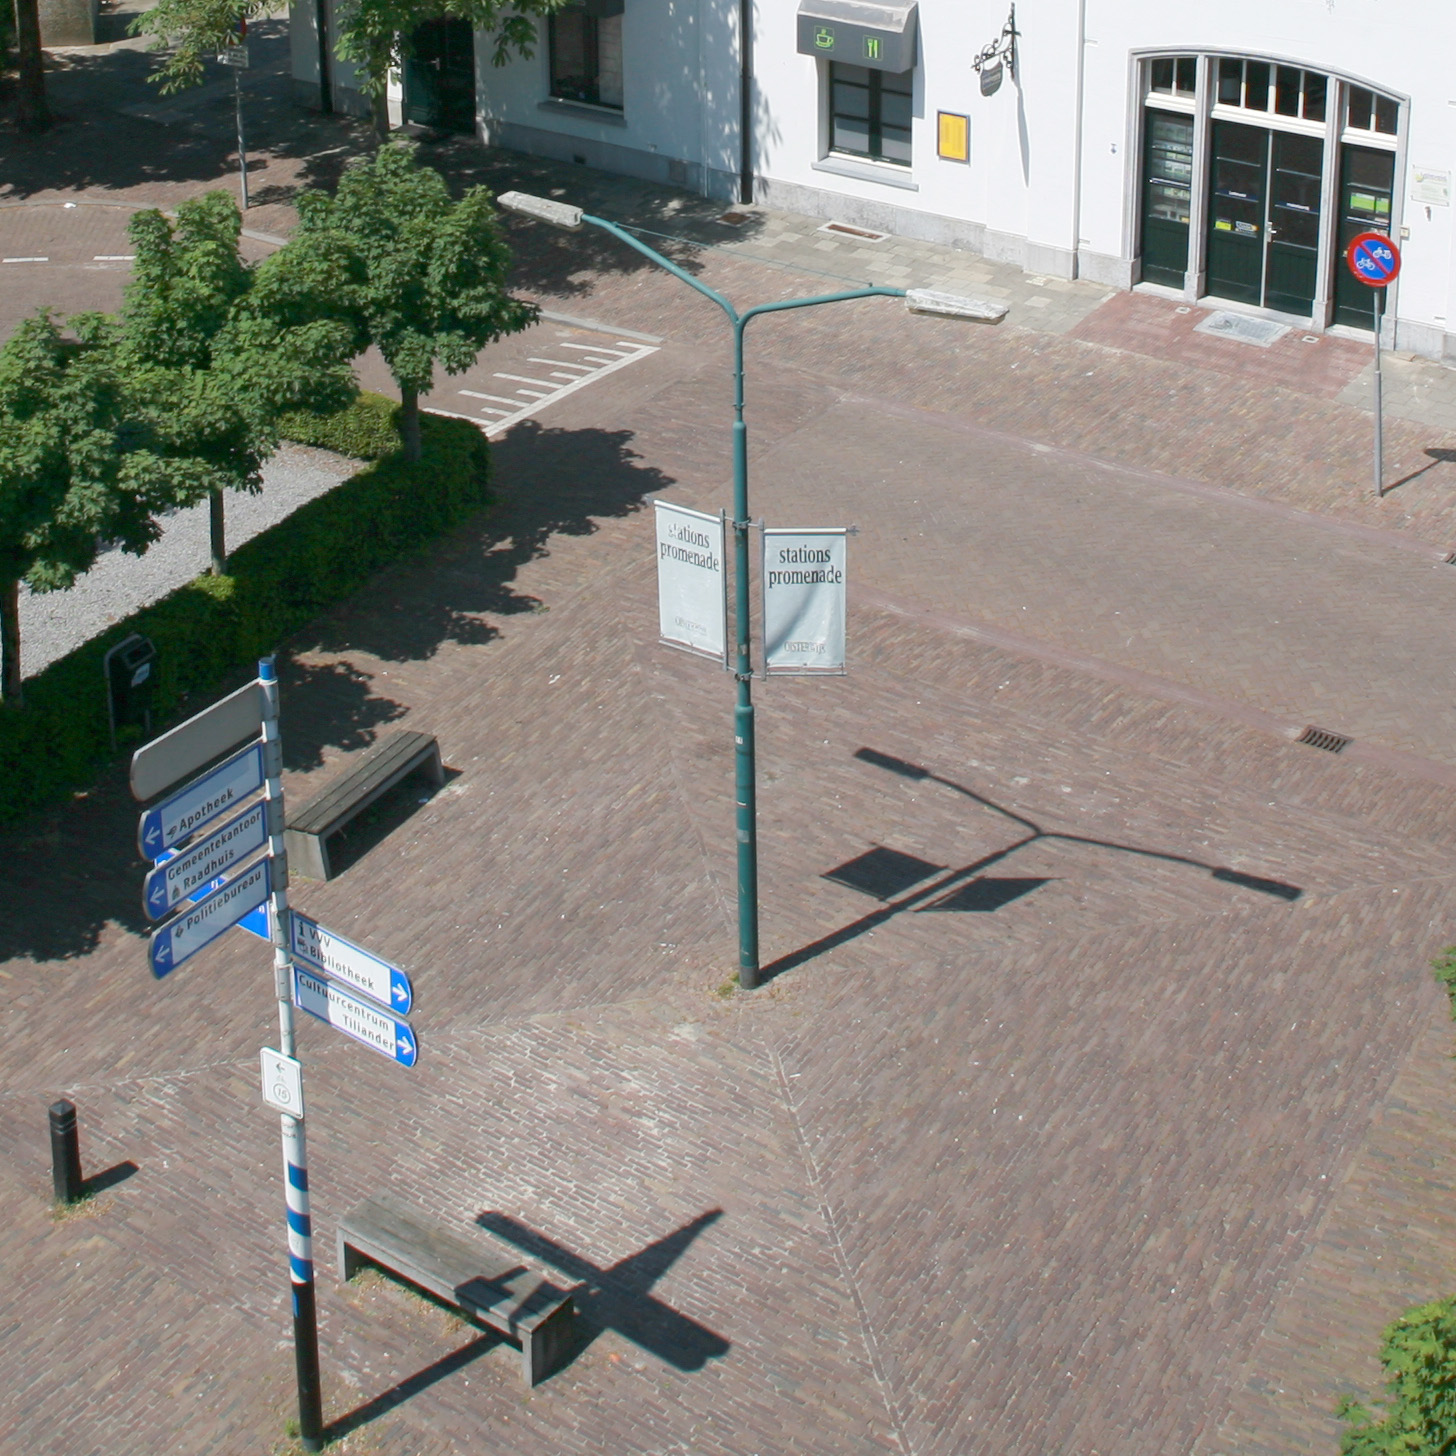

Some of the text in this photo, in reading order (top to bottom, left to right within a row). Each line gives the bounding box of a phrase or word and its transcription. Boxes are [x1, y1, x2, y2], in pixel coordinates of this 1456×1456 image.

[667, 522, 710, 549] stations
[779, 544, 831, 564] stations
[660, 542, 719, 572] promenade
[768, 565, 843, 588] promenade
[179, 788, 234, 832] Apotheek
[168, 811, 261, 881] Gemeentekantoor
[183, 849, 234, 890] Raadhuis
[186, 870, 261, 930] Politiebureau
[310, 928, 331, 948] VVV
[310, 946, 375, 990] Bibliotheek
[299, 974, 389, 1031] Cultuurcentrum
[343, 1013, 395, 1051] Tiliander
